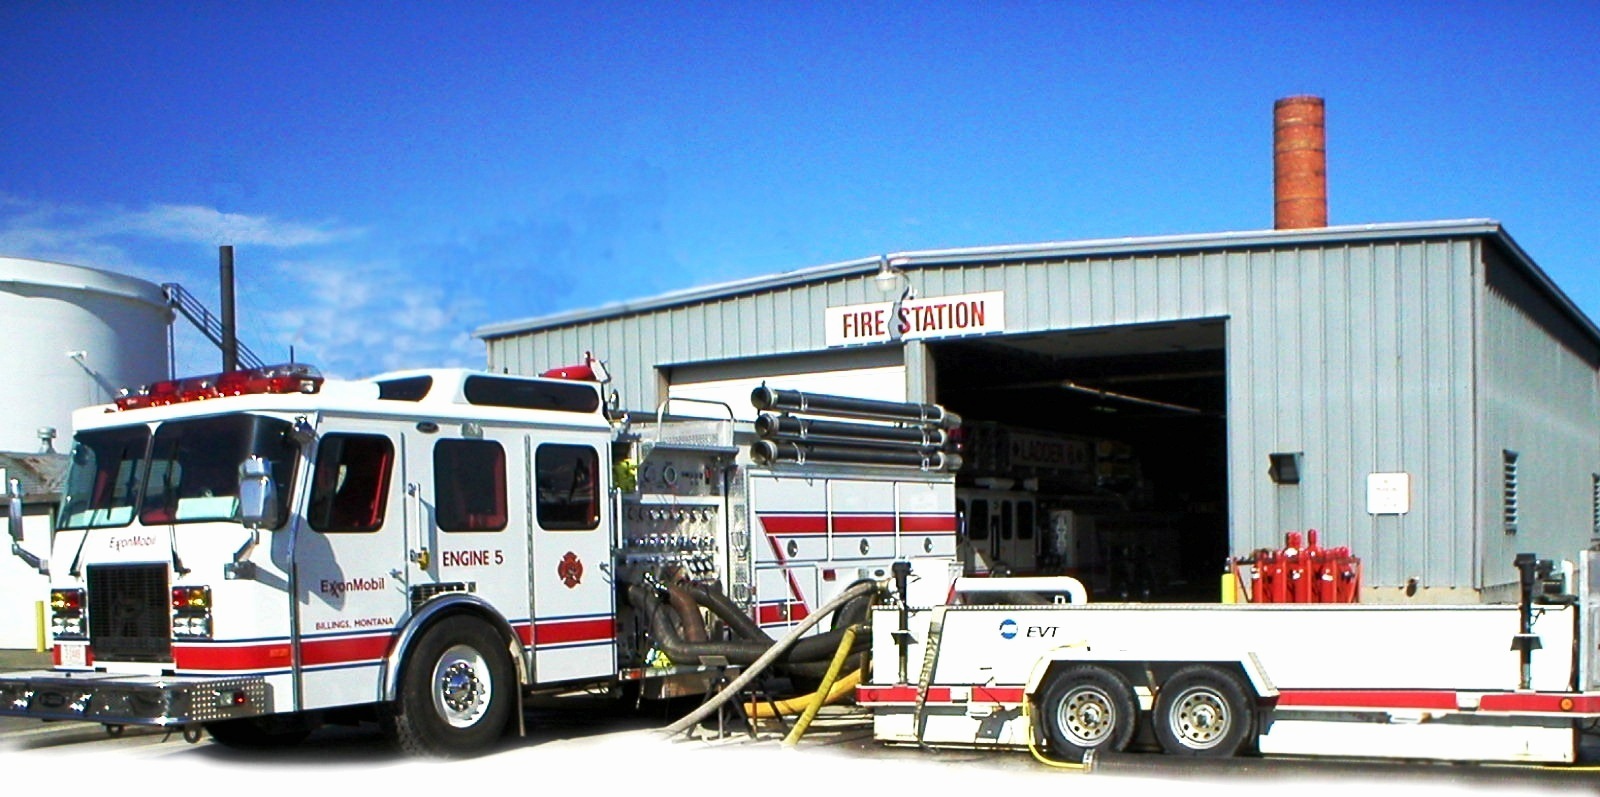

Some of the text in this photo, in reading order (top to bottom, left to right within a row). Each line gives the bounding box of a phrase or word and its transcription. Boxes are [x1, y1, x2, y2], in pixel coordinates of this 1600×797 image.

[842, 300, 985, 338] FIRE STATION
[442, 550, 504, 566] ENGINE 5
[320, 577, 385, 598] ExxonMobil
[354, 617, 394, 627] MONTANA
[1026, 626, 1060, 638] EVT
